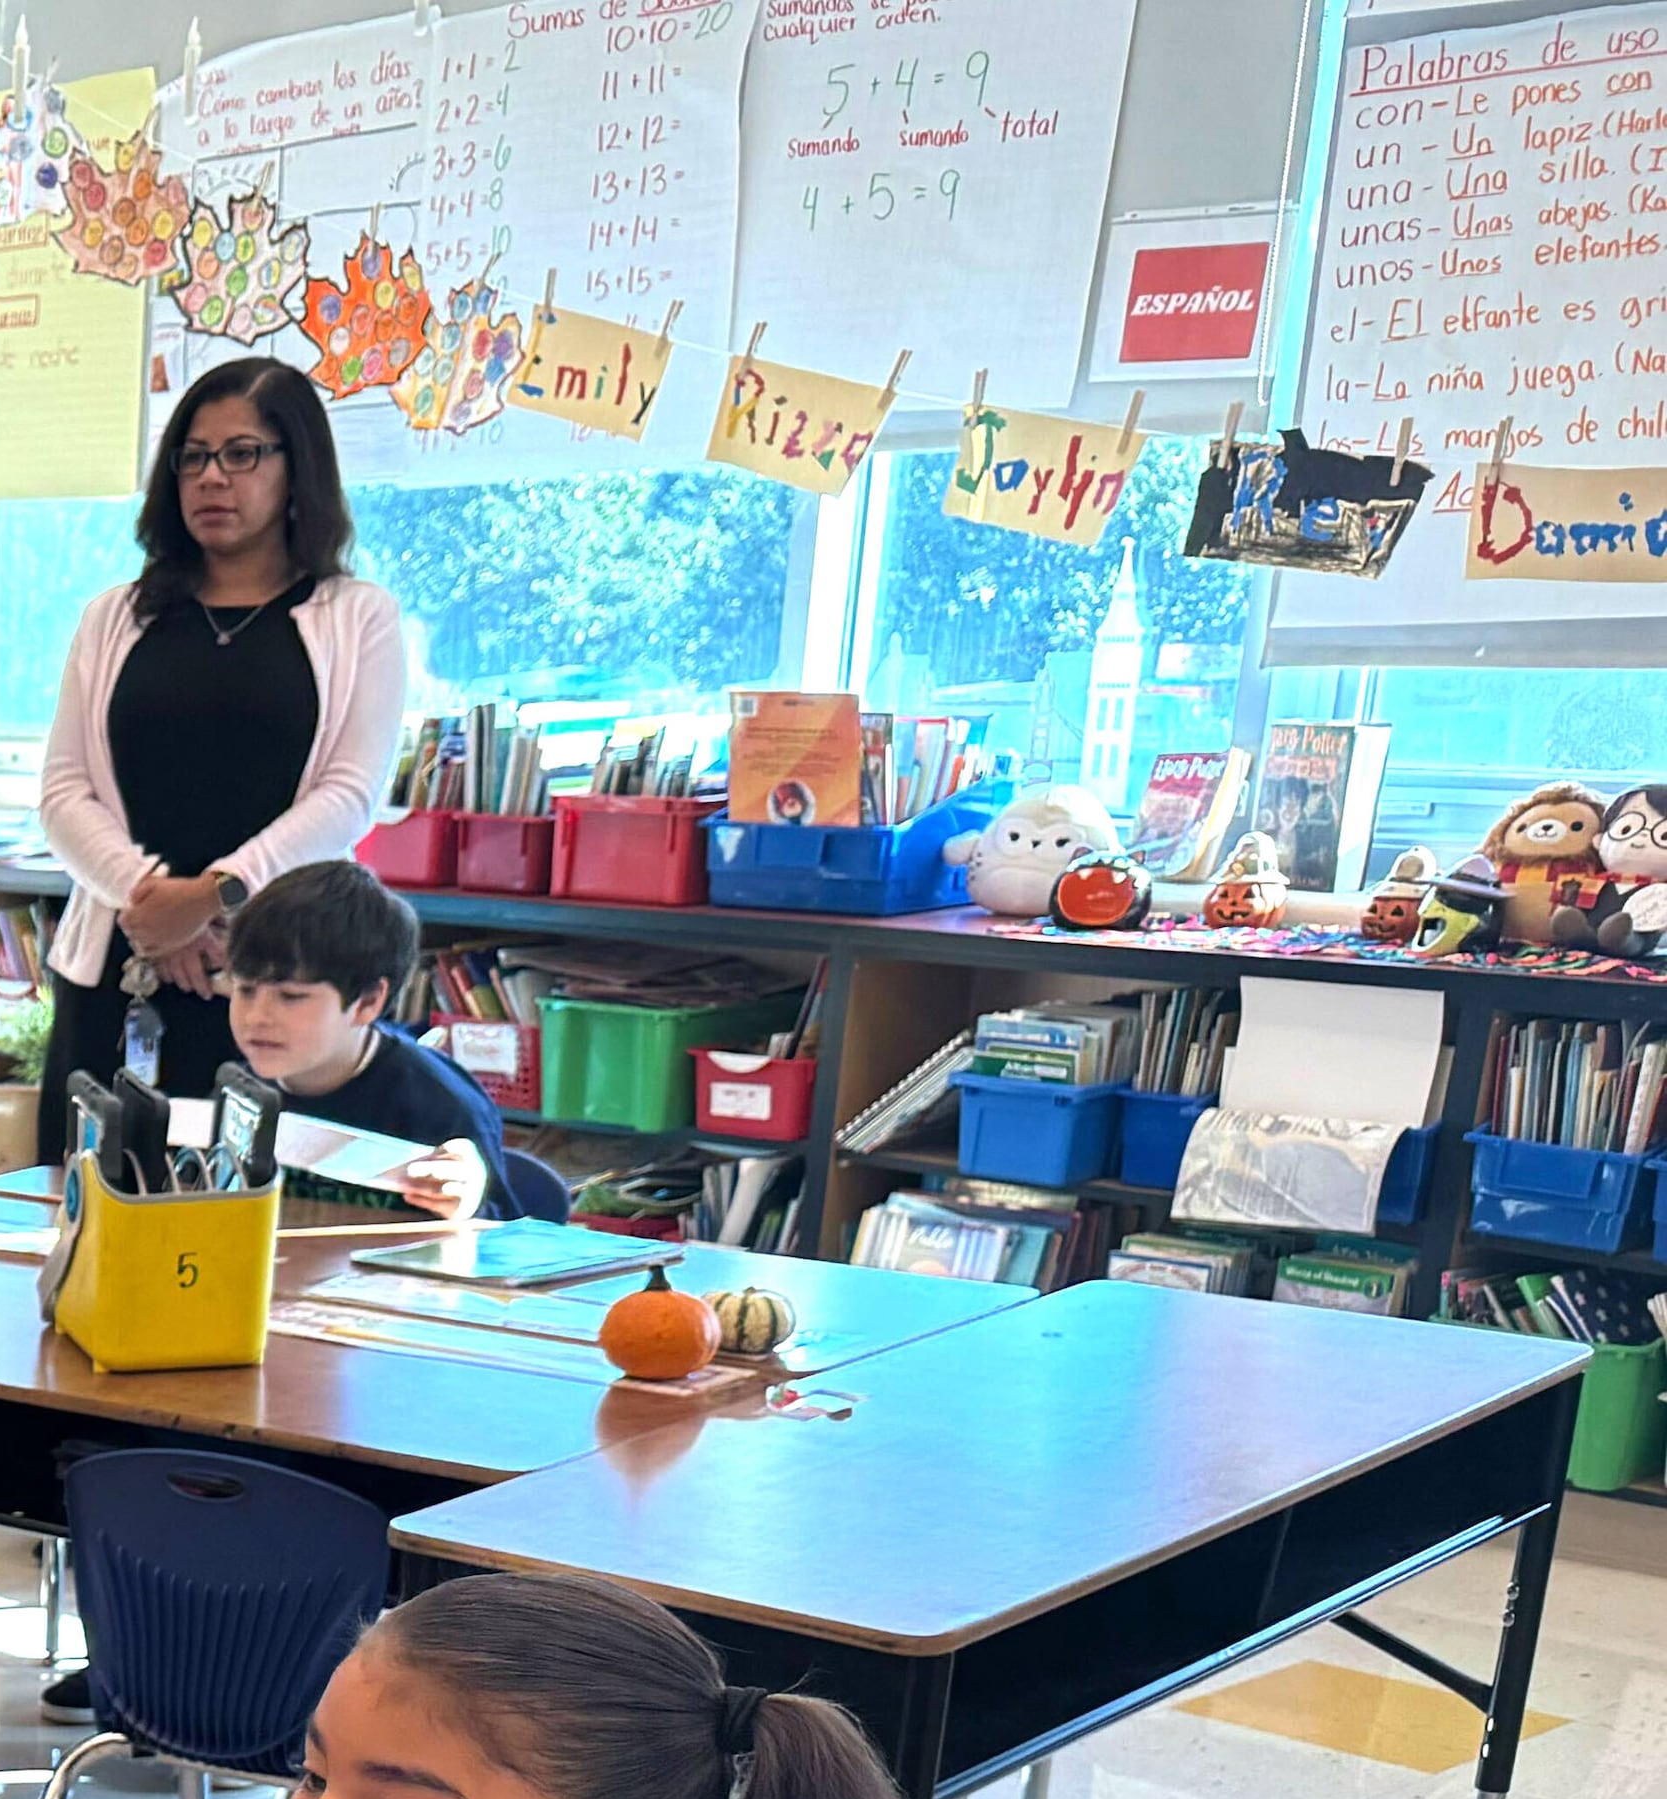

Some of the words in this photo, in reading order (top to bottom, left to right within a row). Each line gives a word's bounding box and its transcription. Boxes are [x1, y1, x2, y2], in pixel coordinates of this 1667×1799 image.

[508, 5, 585, 39] Sumas
[763, 16, 856, 46] cualquier
[1359, 39, 1509, 91] Palabras
[1541, 21, 1578, 66] de
[1606, 27, 1660, 56] uso
[822, 63, 856, 117] 5
[894, 57, 919, 108] 4
[965, 50, 990, 107] 9
[1511, 79, 1582, 117] pones
[1605, 69, 1653, 96] con
[787, 126, 861, 160] sumando
[899, 119, 970, 149] sumando
[1001, 109, 1059, 143] total
[1538, 146, 1616, 184] silla.
[802, 184, 820, 232] 4
[869, 172, 895, 220] 5
[939, 168, 961, 221] 9
[1537, 192, 1617, 233] abejas.
[1130, 284, 1256, 316] ESPAÑOL
[1562, 300, 1596, 323] es
[1426, 364, 1485, 395] niña
[1506, 356, 1603, 399] juega.
[1566, 404, 1599, 445] de
[176, 1251, 200, 1289] 5
